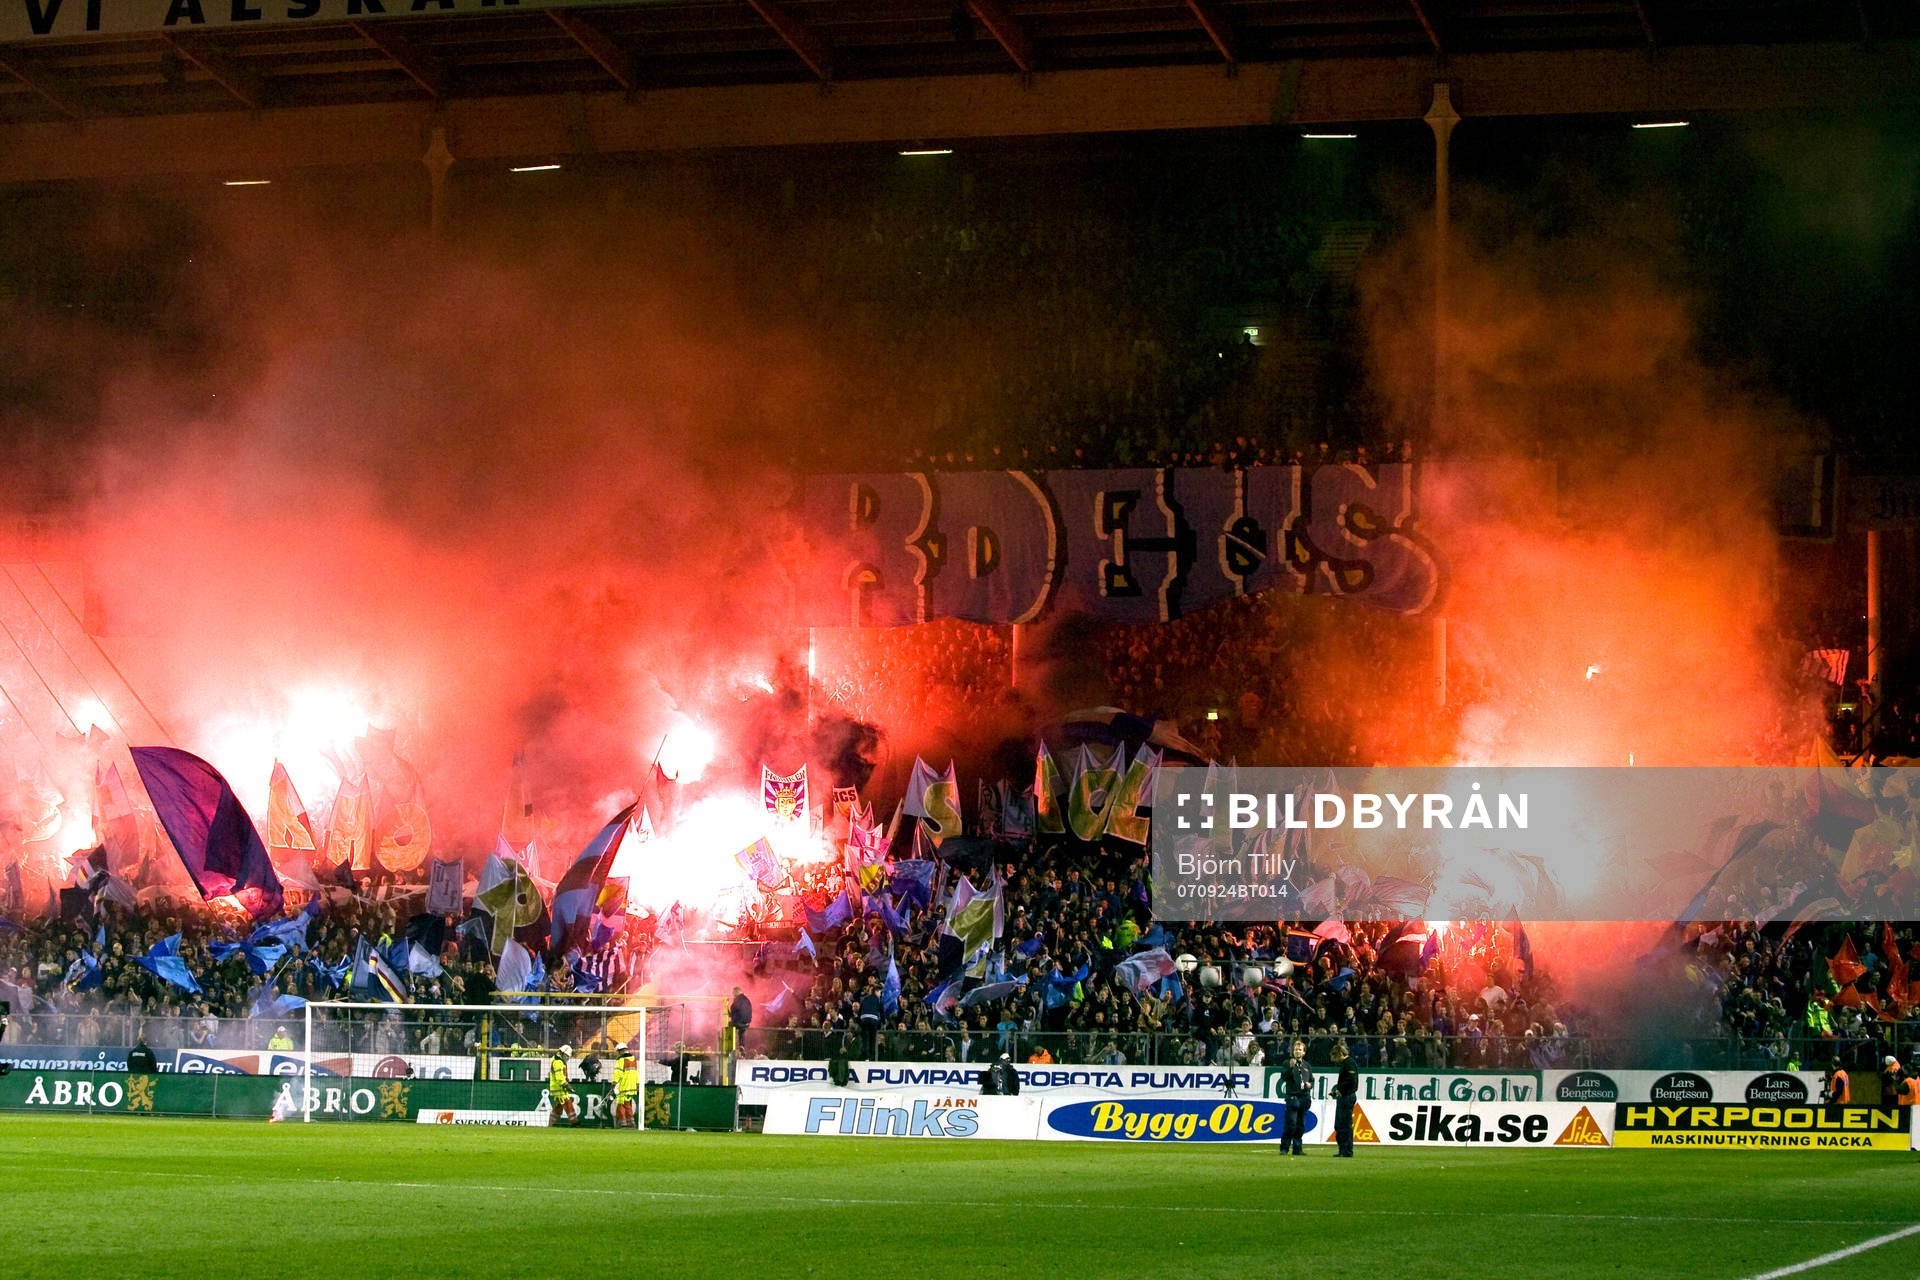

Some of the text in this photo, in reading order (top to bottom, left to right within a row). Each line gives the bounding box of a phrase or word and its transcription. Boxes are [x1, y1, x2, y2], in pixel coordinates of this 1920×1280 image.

[751, 1066, 981, 1085] ROBOA PUMPAR
[1018, 1070, 1249, 1089] ROBOTA PUMPAR
[1576, 1076, 1600, 1088] Lars
[1670, 1077, 1695, 1088] Lars
[1765, 1077, 1790, 1089] Lars
[25, 1076, 123, 1107] ÅBRO
[272, 1082, 376, 1114] ÅBRO
[1366, 1077, 1439, 1101] Lind
[1449, 1077, 1533, 1102] Golv
[1560, 1087, 1615, 1099] Bengtsson
[1655, 1088, 1709, 1100] Bengtsson
[1750, 1089, 1804, 1100] Bengtsson
[934, 1098, 978, 1108] JÄRN
[805, 1097, 979, 1137] Flinks
[1389, 1105, 1548, 1143] sika.se
[1626, 1106, 1899, 1129] HYRPOOLEN
[1562, 1115, 1602, 1145] Sika
[1651, 1134, 1873, 1147] MASKINUTHYRNING NACKA
